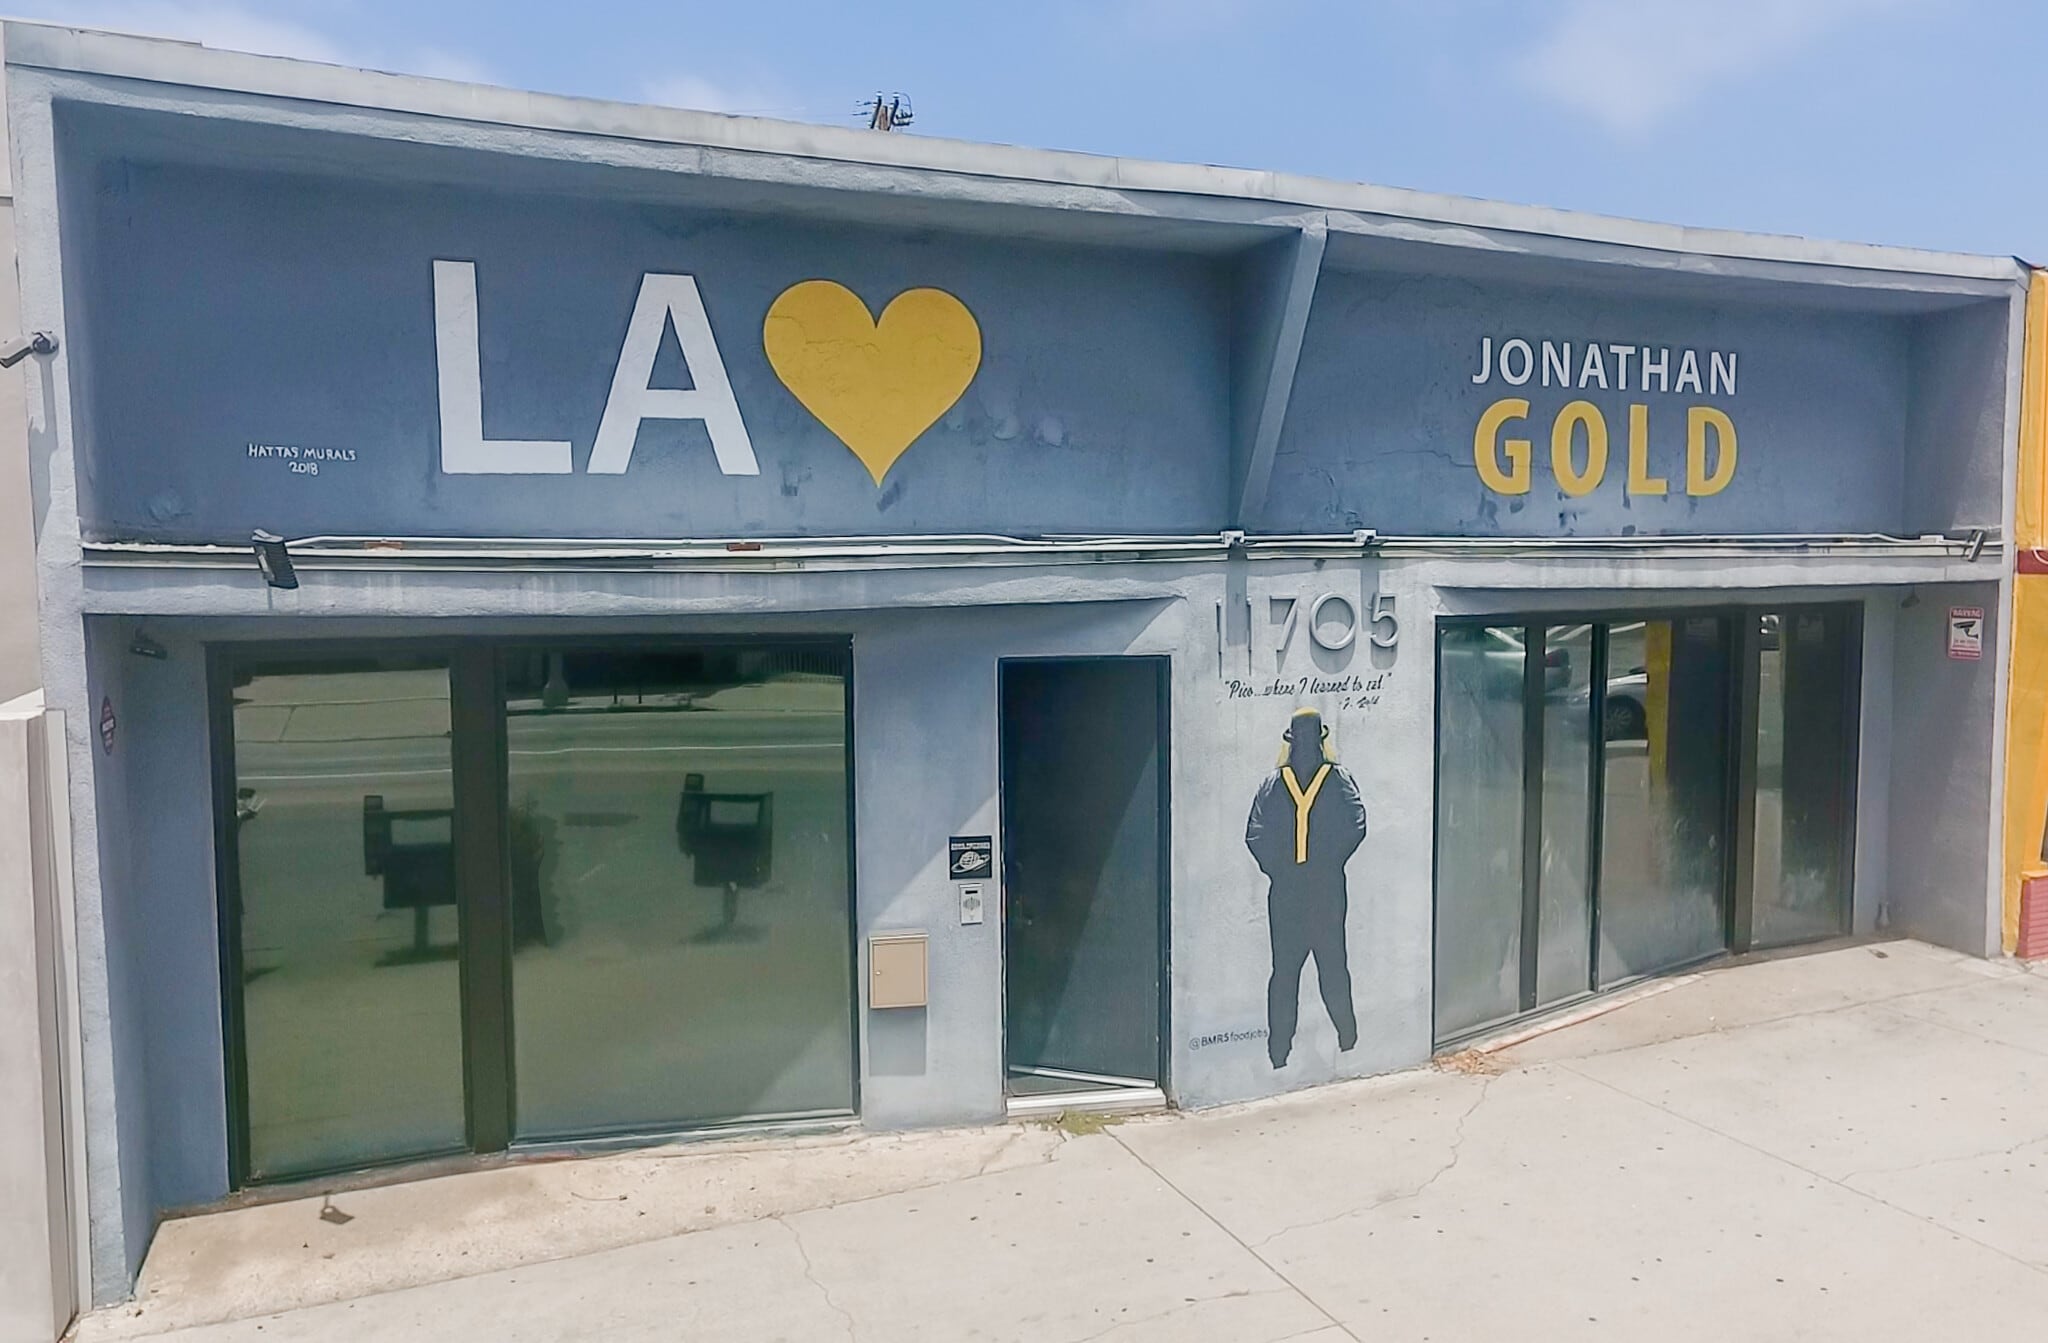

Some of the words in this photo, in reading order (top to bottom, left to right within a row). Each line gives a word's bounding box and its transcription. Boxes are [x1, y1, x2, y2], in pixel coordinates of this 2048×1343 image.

[433, 260, 760, 475] LA
[1472, 337, 1737, 395] JONATHAN
[248, 443, 299, 458] HATTAS
[303, 448, 356, 461] MURALS
[288, 461, 318, 475] 2018
[1474, 398, 1738, 497] GOLD
[1216, 592, 1399, 652] 11705
[1352, 675, 1362, 691] to
